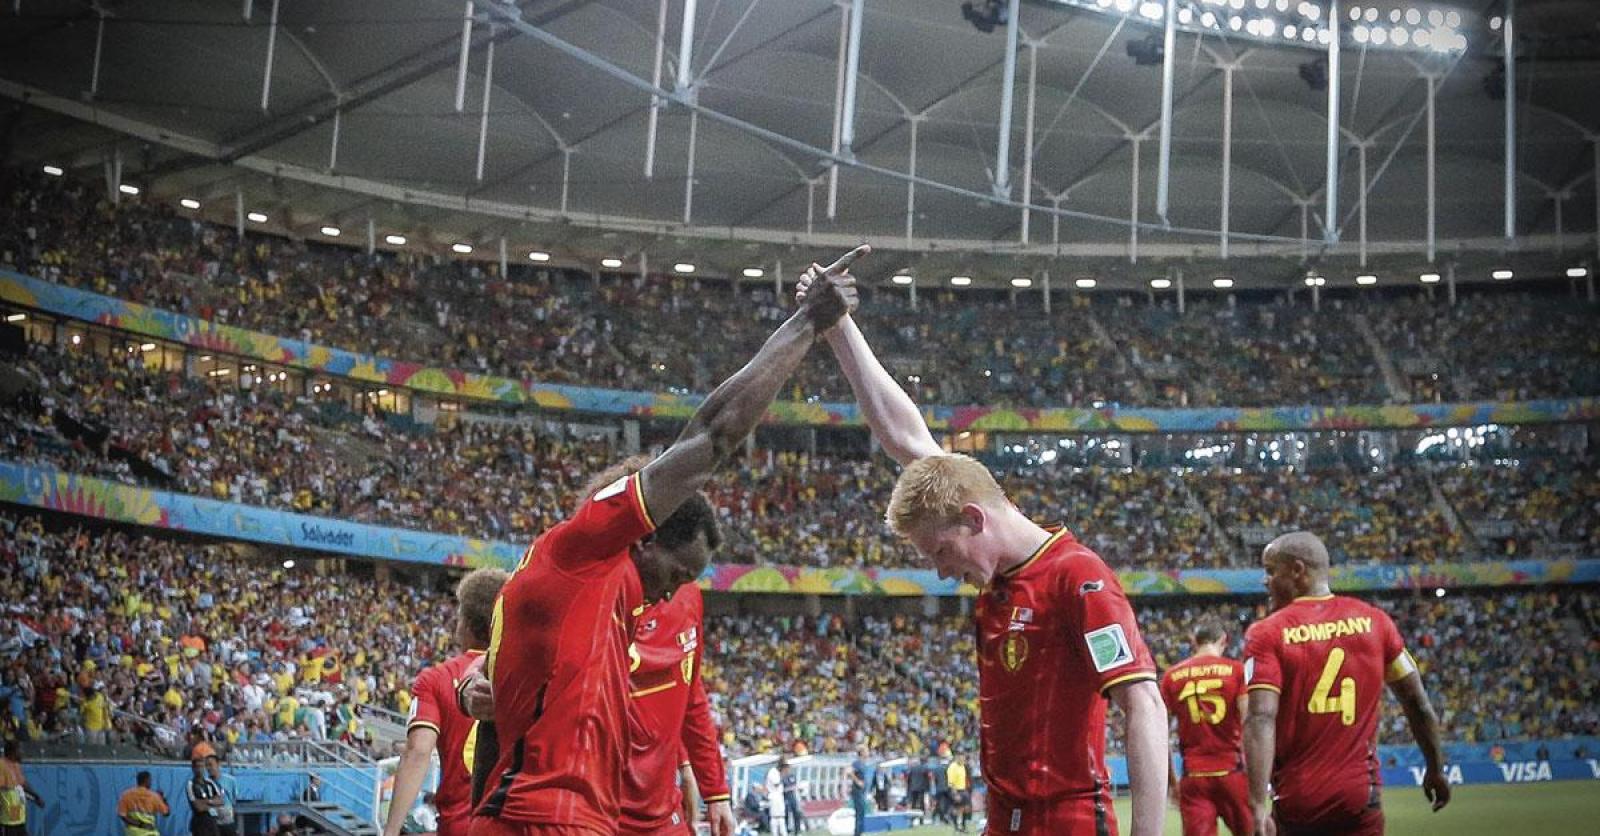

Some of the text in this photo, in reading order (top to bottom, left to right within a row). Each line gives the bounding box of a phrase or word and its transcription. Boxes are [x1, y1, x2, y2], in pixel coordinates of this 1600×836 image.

[301, 522, 354, 547] Salvador
[1283, 617, 1371, 645] KOMPANY
[1308, 647, 1355, 726] 4
[1178, 678, 1226, 725] 15
[1409, 764, 1463, 786] VA
[1499, 760, 1553, 782] VISA
